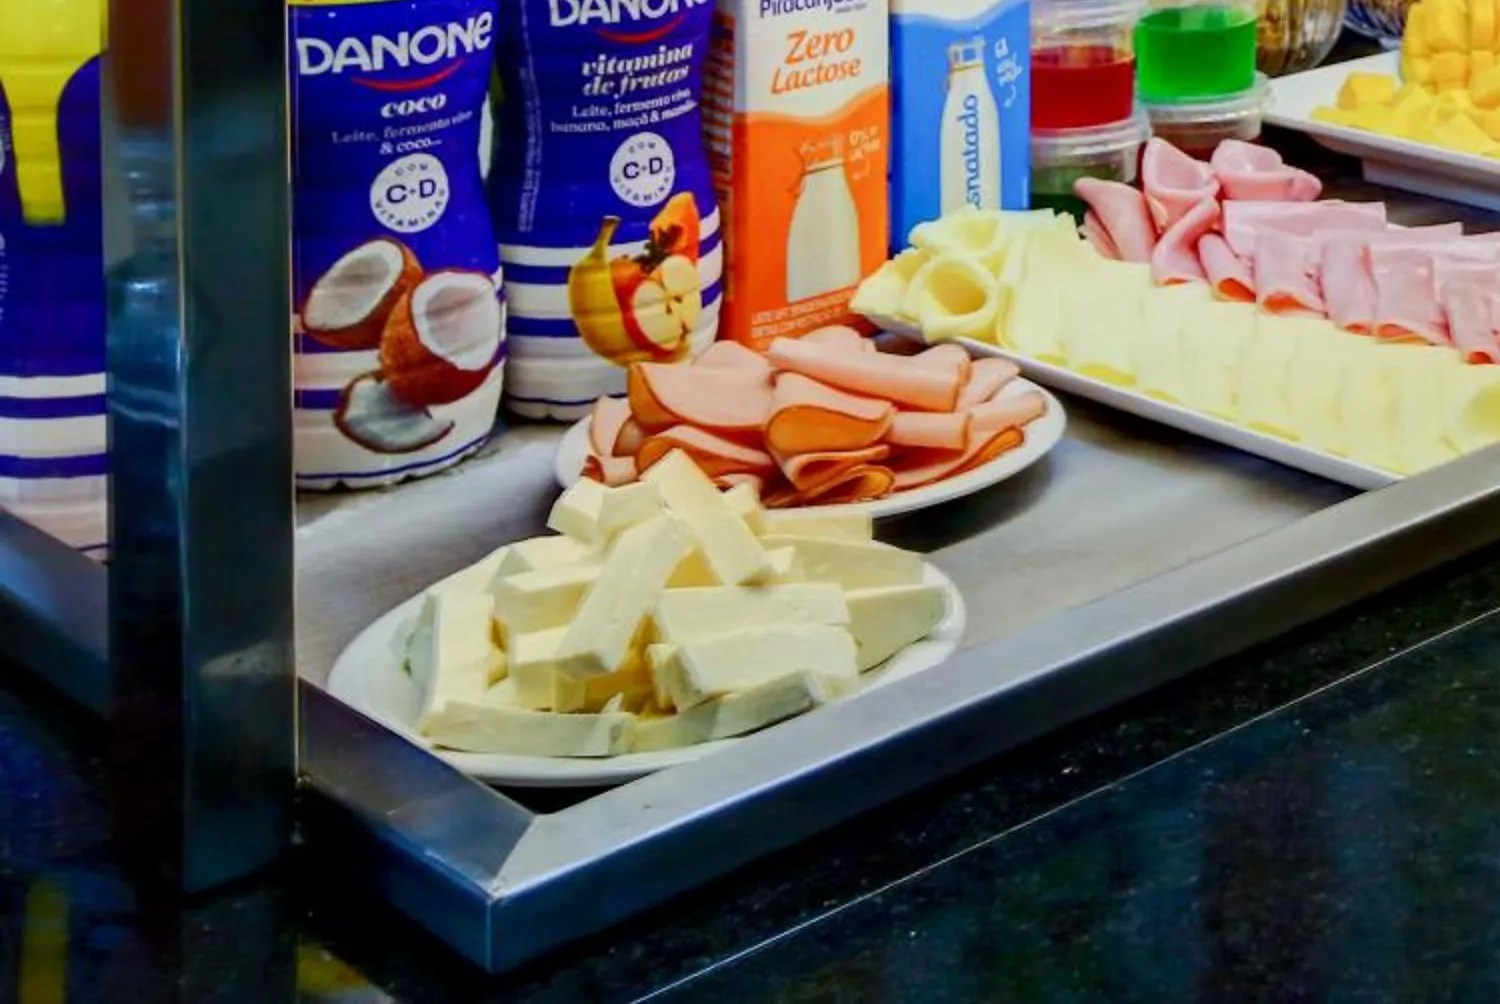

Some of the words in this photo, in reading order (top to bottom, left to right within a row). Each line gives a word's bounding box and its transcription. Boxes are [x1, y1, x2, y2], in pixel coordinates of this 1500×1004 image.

[581, 43, 694, 77] vitamina
[784, 26, 855, 65] Zero
[582, 75, 615, 96] de
[612, 65, 690, 99] frutas
[770, 56, 862, 97] Lactose
[380, 92, 447, 119] coco
[379, 141, 394, 156] &
